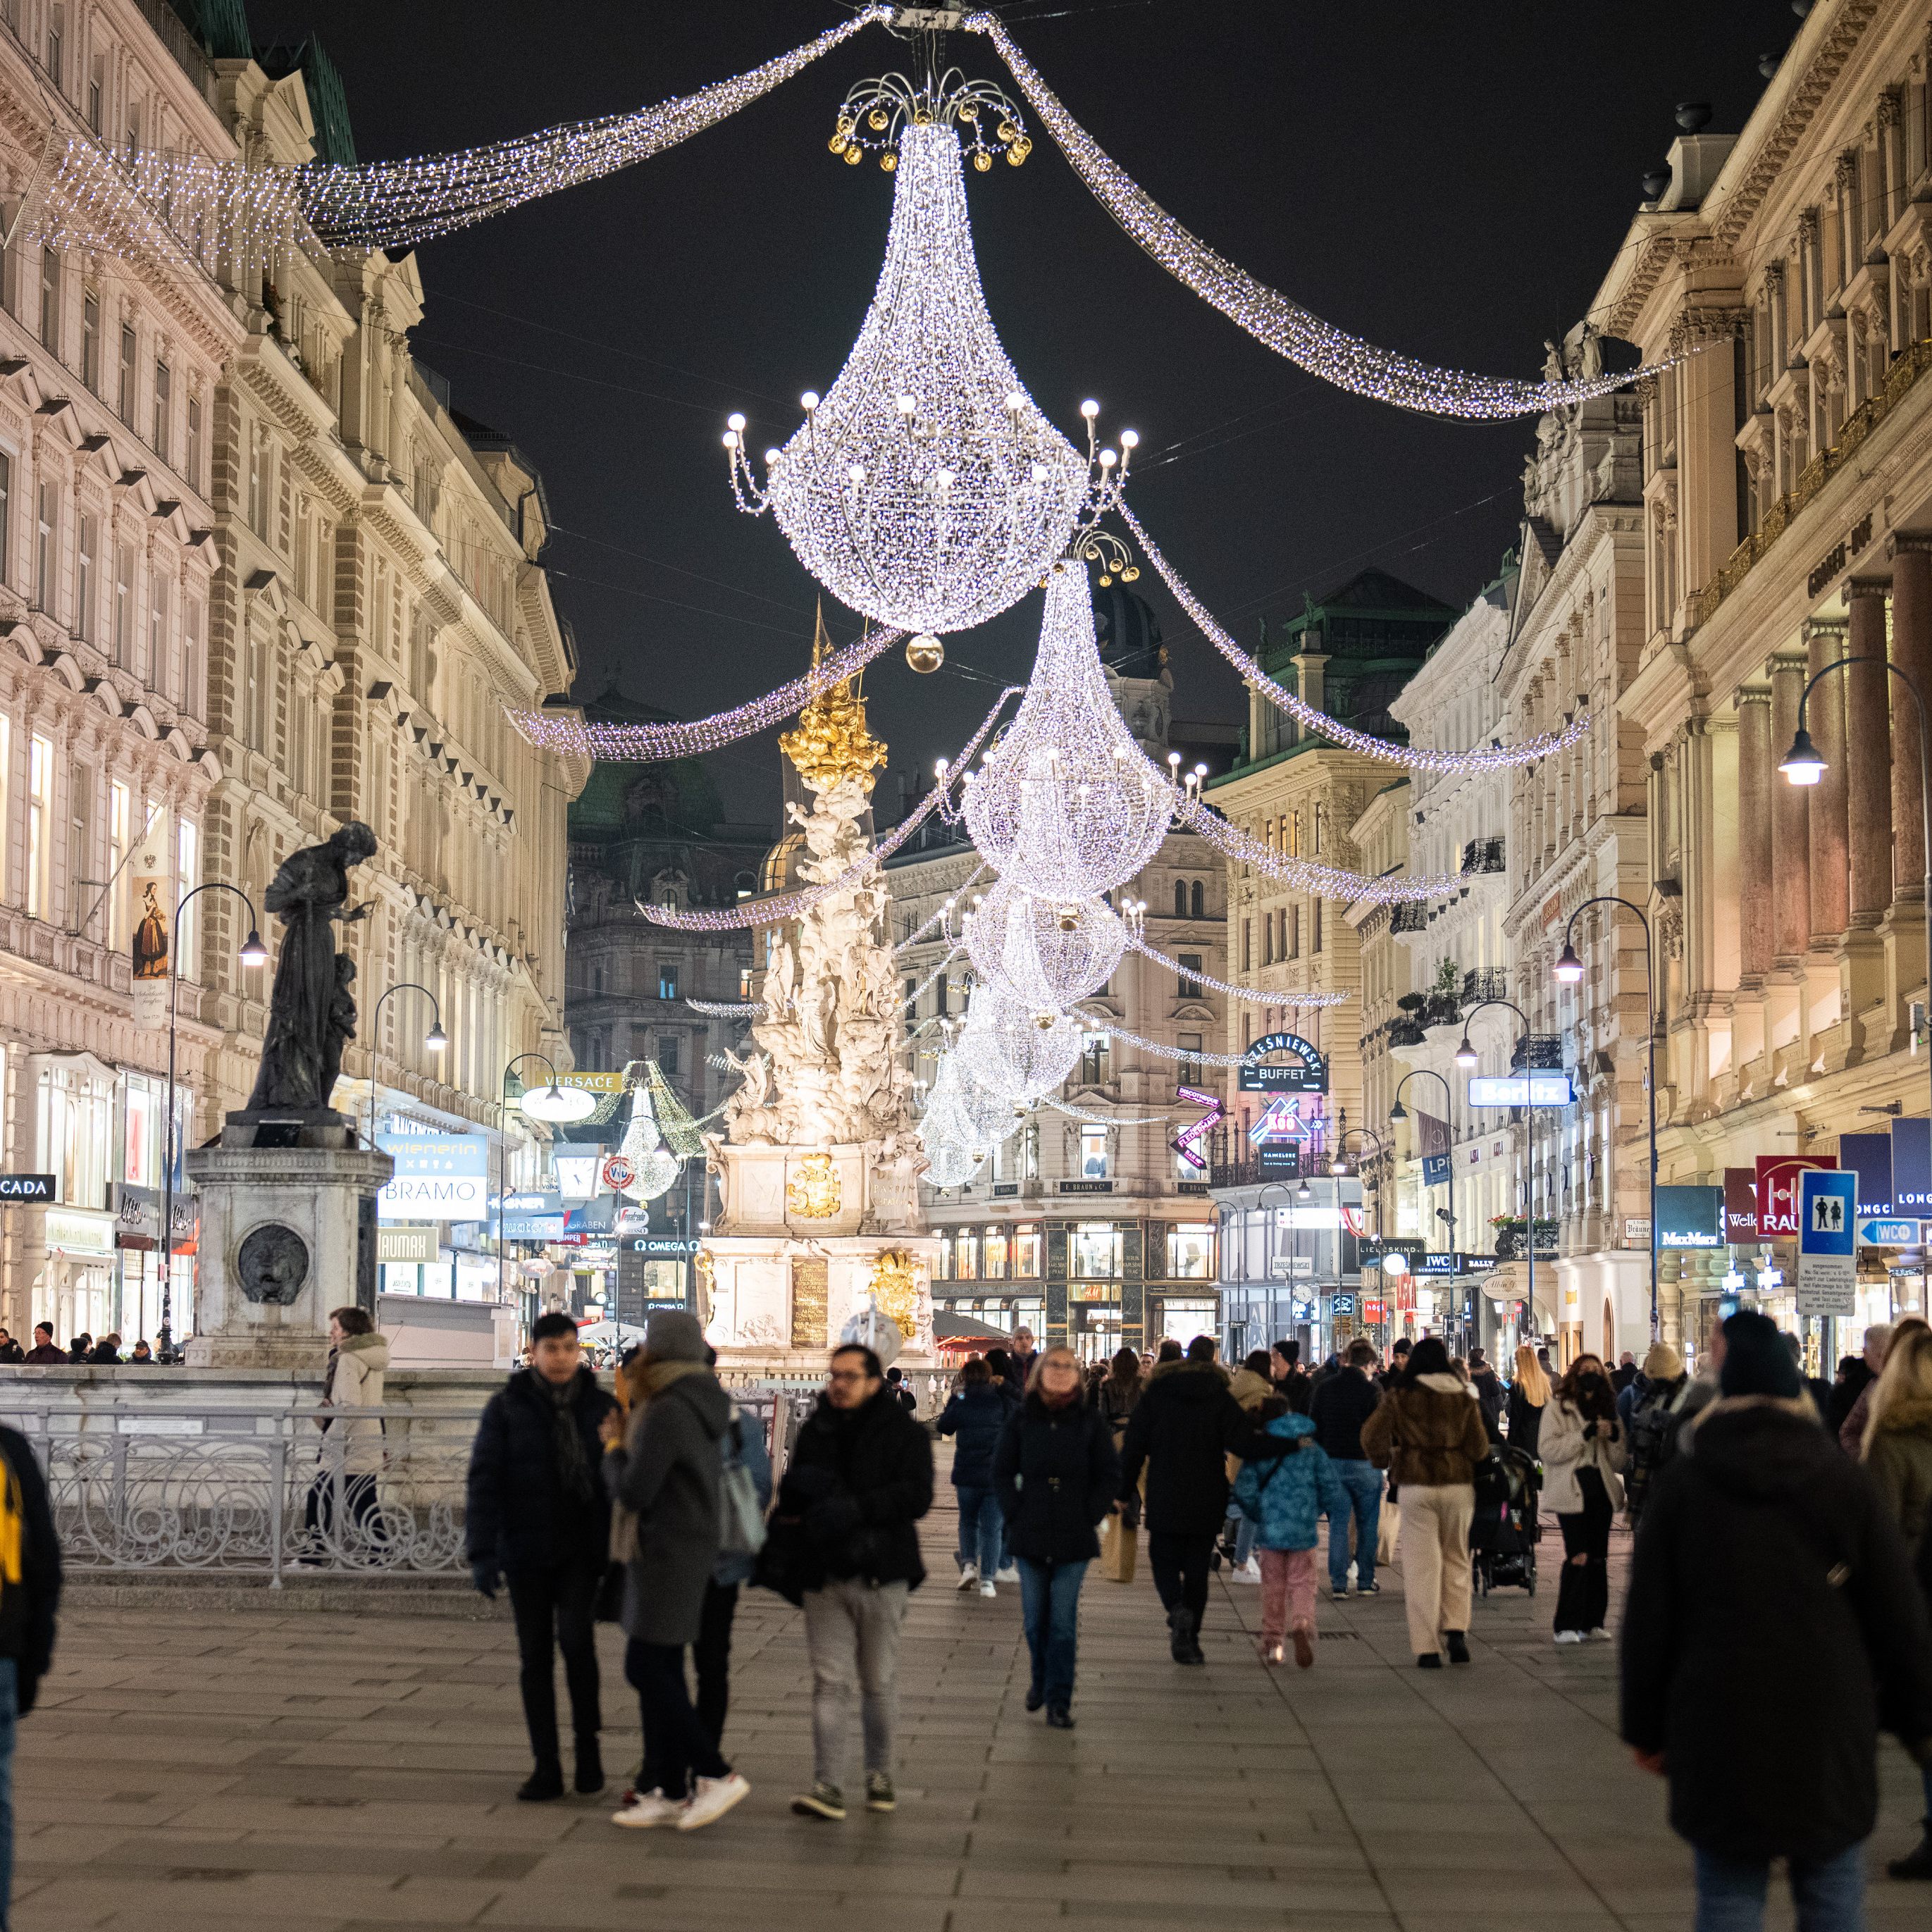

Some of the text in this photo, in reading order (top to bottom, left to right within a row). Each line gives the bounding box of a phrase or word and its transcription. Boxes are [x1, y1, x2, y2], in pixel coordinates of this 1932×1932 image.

[1259, 1068, 1306, 1079] BUFFET
[545, 1076, 614, 1088] VERSACE
[1179, 1087, 1220, 1106] DISCOTHEQUE
[1480, 1081, 1559, 1101] Berlitz
[1177, 1113, 1221, 1148] FLEDERMAUS
[387, 1142, 478, 1156] wienerin
[0, 1180, 47, 1194] CADA
[385, 1182, 476, 1201] BRAMO
[569, 1220, 606, 1230] GRABEN
[378, 1233, 427, 1258] AUMAX
[1661, 1231, 1718, 1246] MaxMara
[648, 1241, 687, 1251] OMEGA
[1425, 1256, 1450, 1267] IWC
[1084, 1285, 1100, 1298] H&M
